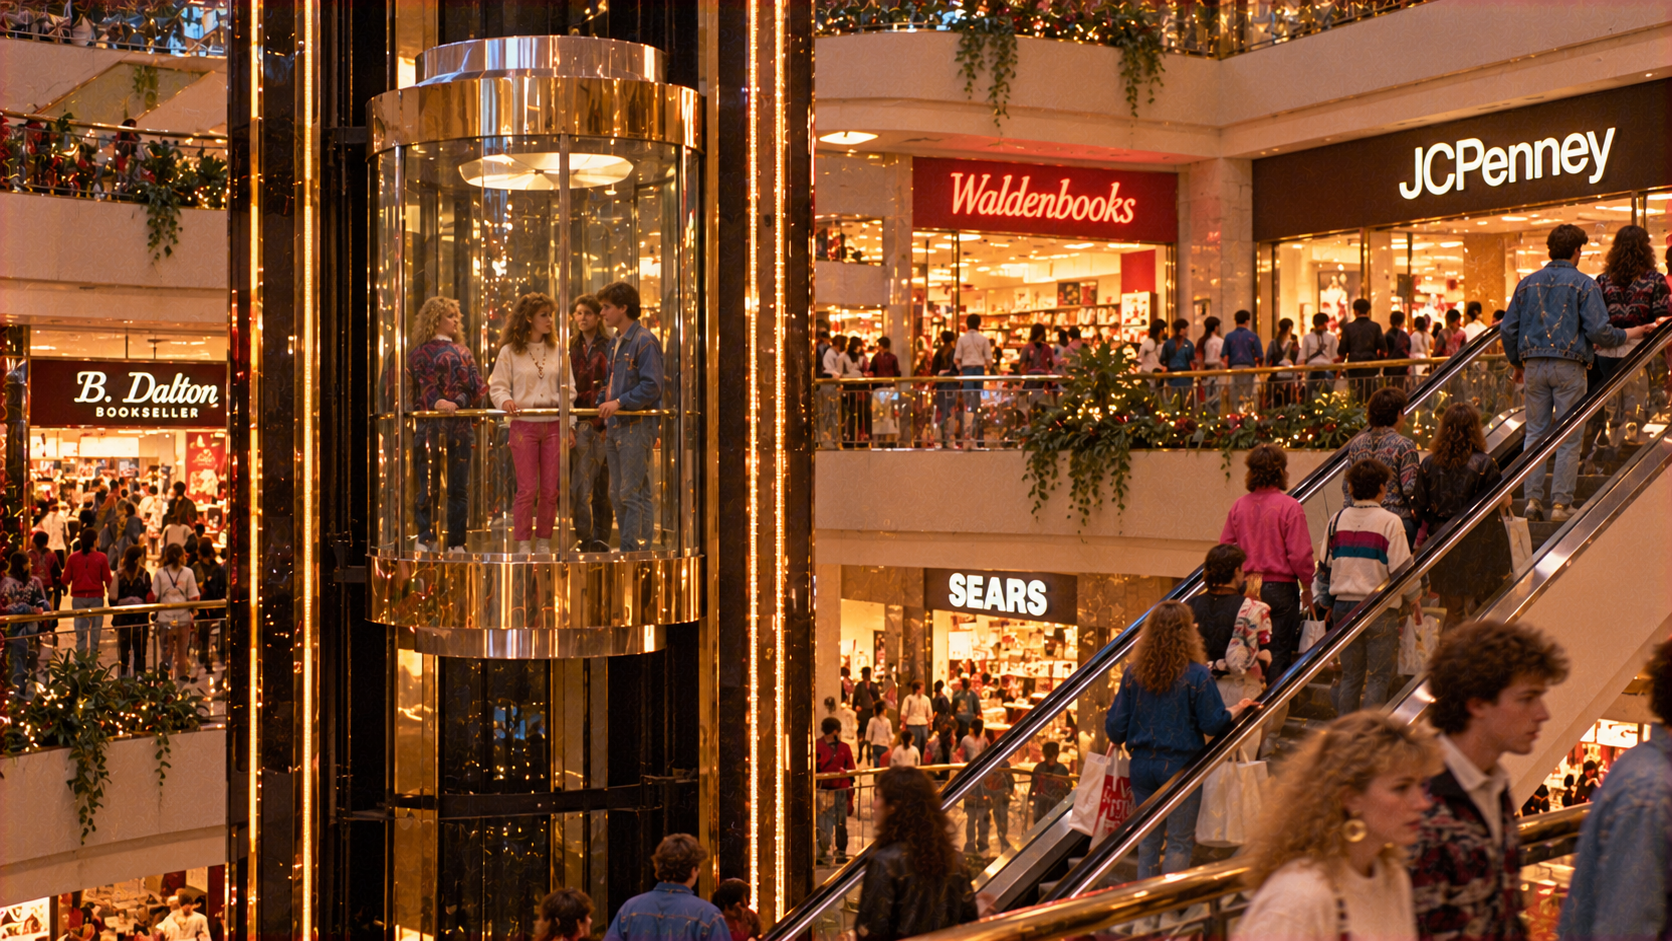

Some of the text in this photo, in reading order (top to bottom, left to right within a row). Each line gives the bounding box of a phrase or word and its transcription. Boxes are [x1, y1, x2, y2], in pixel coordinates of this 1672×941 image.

[1399, 127, 1616, 200] JCPenney
[951, 172, 1136, 224] Waldenbooks
[74, 371, 219, 407] B. Dalton
[96, 407, 198, 418] BOOKSELLER
[948, 572, 1047, 617] SEARS
